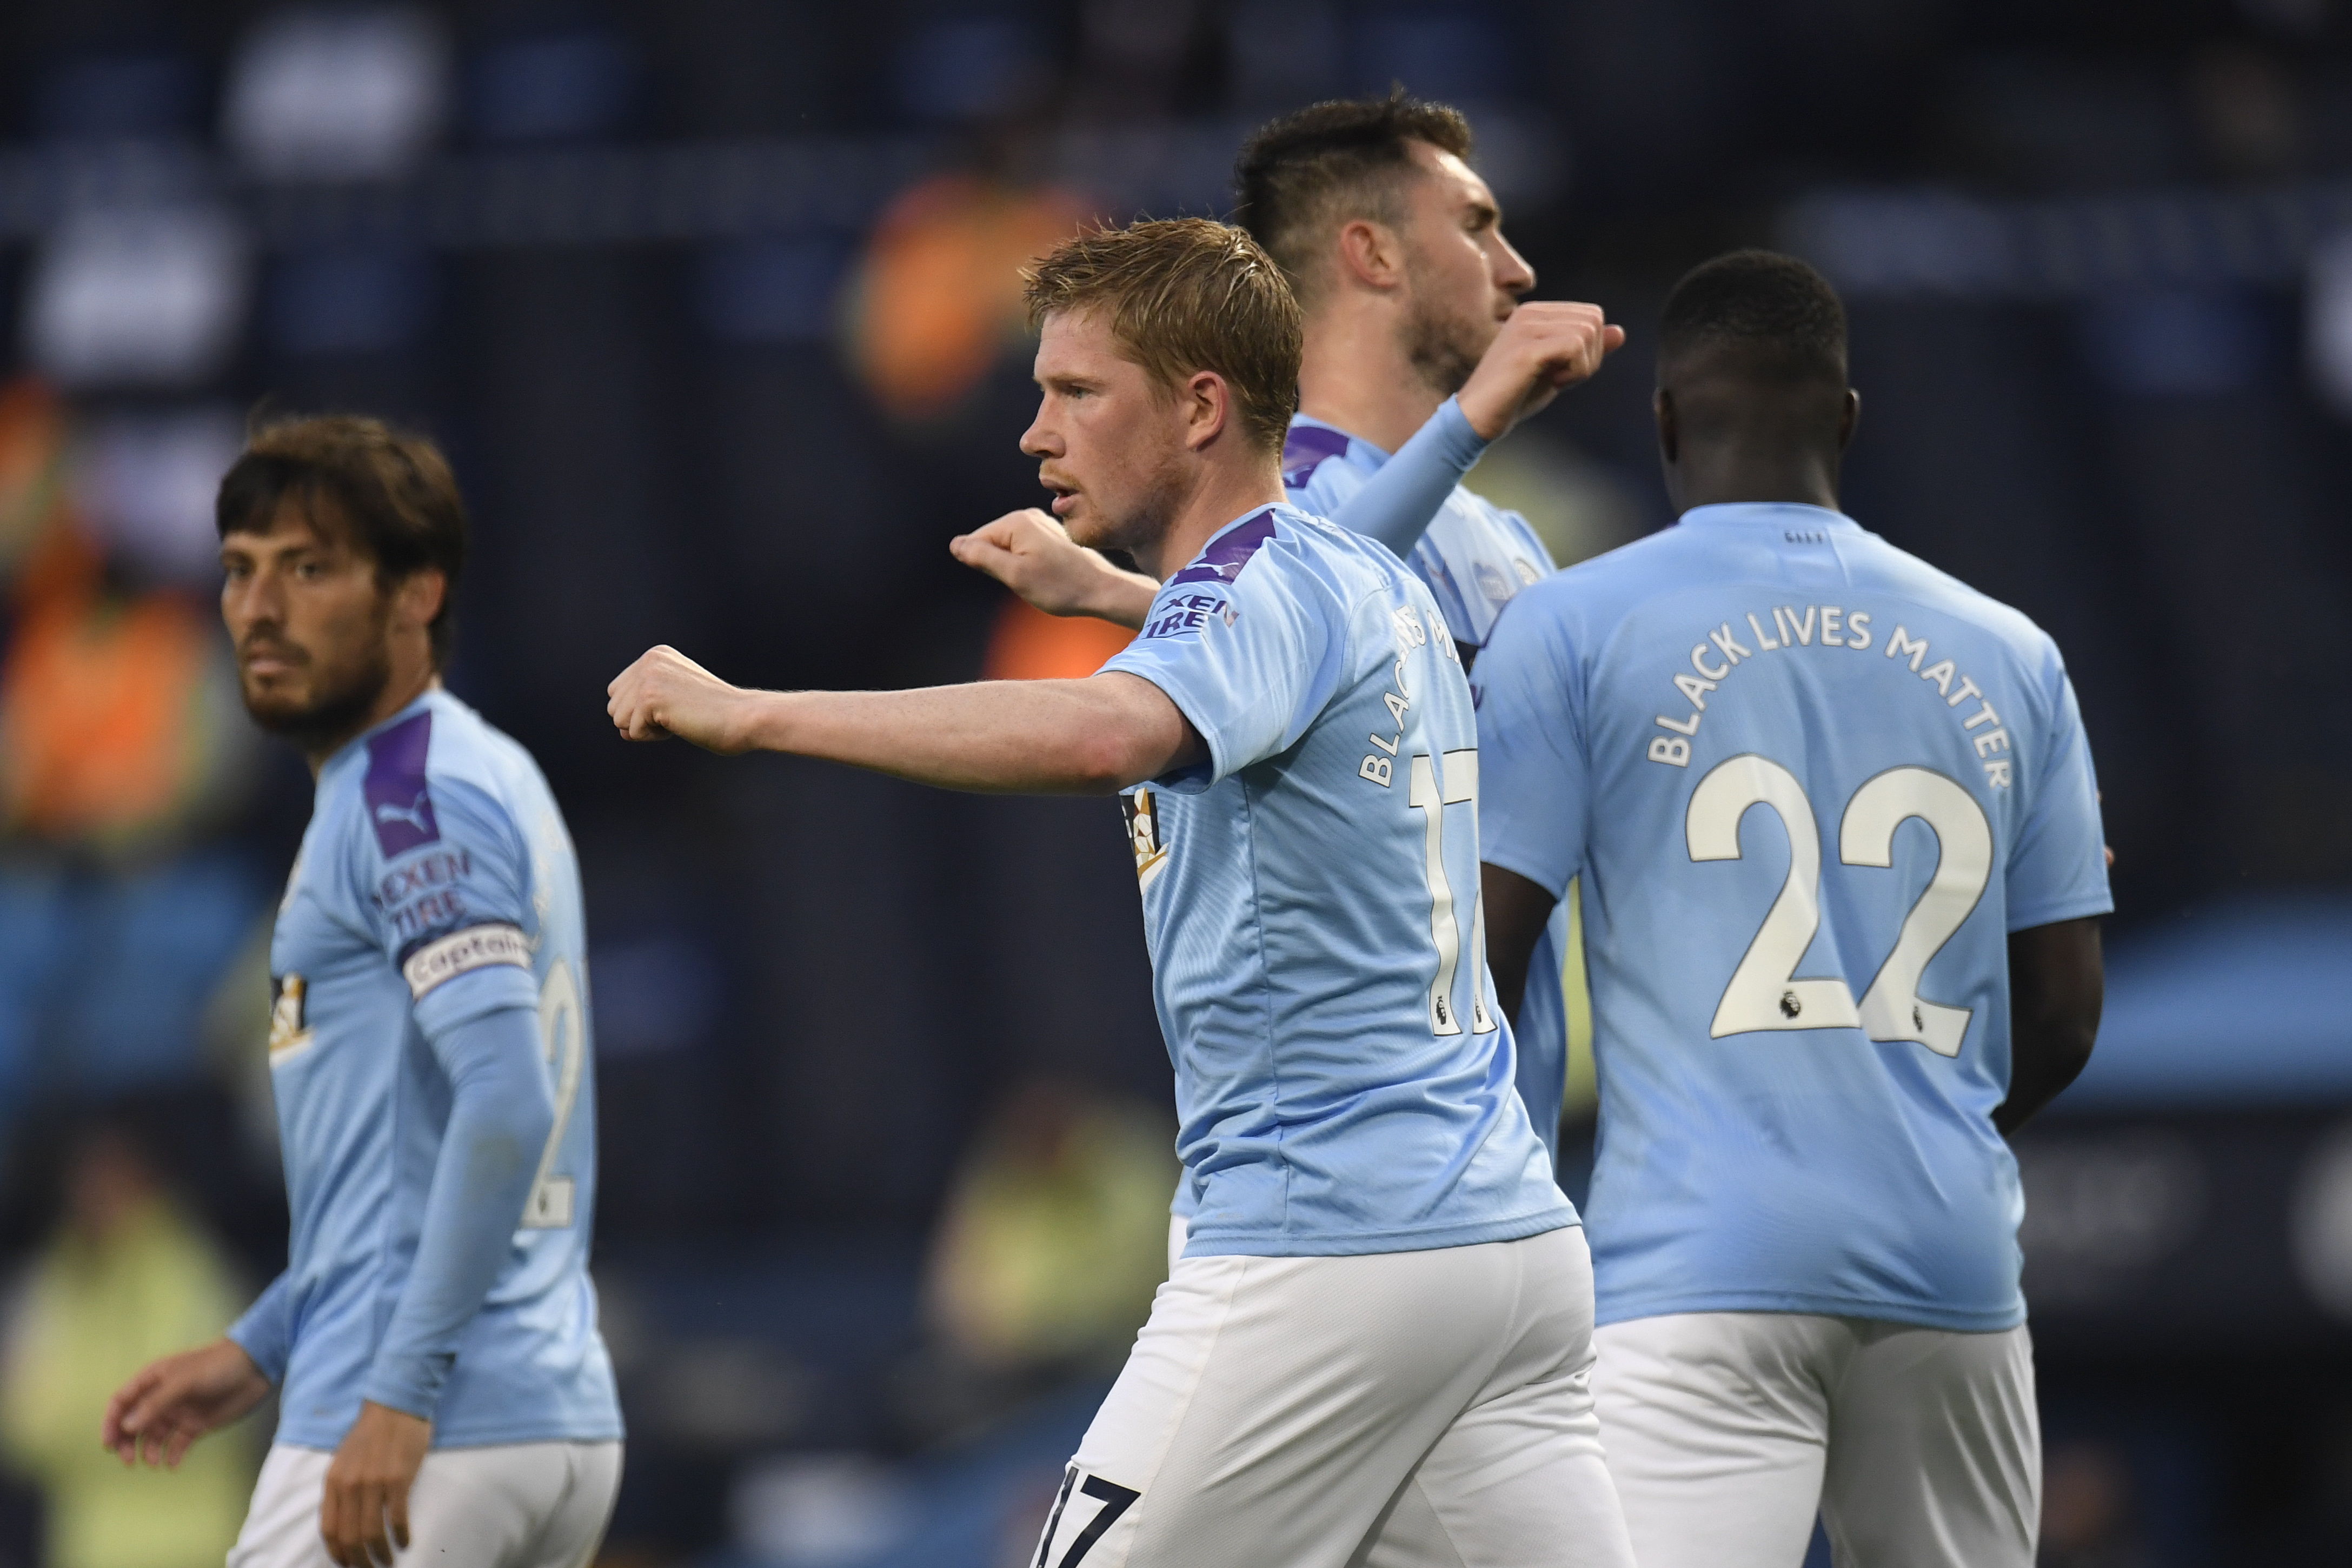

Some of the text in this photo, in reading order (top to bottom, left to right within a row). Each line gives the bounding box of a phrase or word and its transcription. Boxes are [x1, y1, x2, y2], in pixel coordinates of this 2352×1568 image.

[1647, 604, 2012, 789] BLACK LIVES MATTER
[1409, 748, 1498, 1036] 17
[1685, 752, 1995, 1059] 22
[1036, 1465, 1141, 1568] 17
